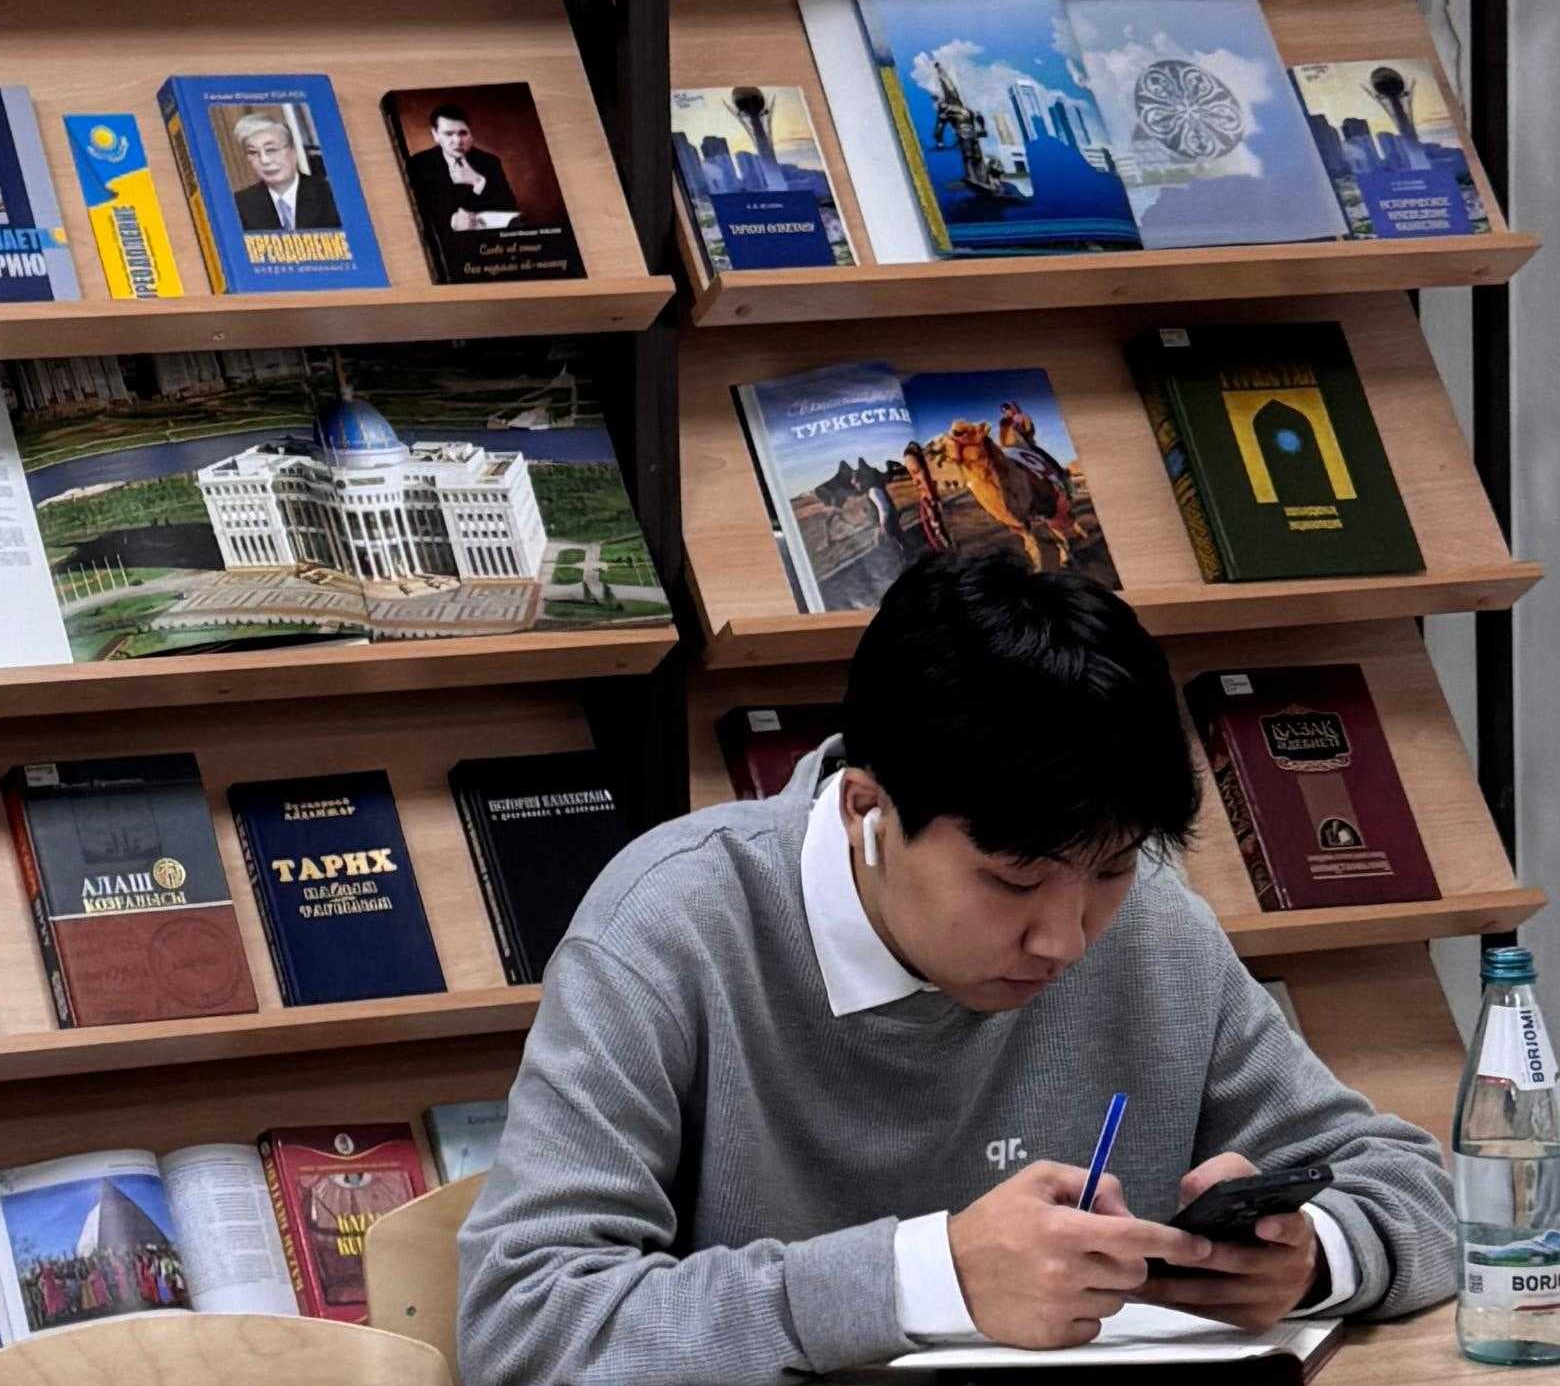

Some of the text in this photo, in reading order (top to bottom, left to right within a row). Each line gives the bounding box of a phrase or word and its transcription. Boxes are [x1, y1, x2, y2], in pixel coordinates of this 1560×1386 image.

[791, 407, 913, 439] ТУРКЕСТАН
[81, 872, 154, 897] АЛАШ
[1520, 1009, 1545, 1083] BORJOMI
[1512, 1273, 1560, 1291] BORJ
